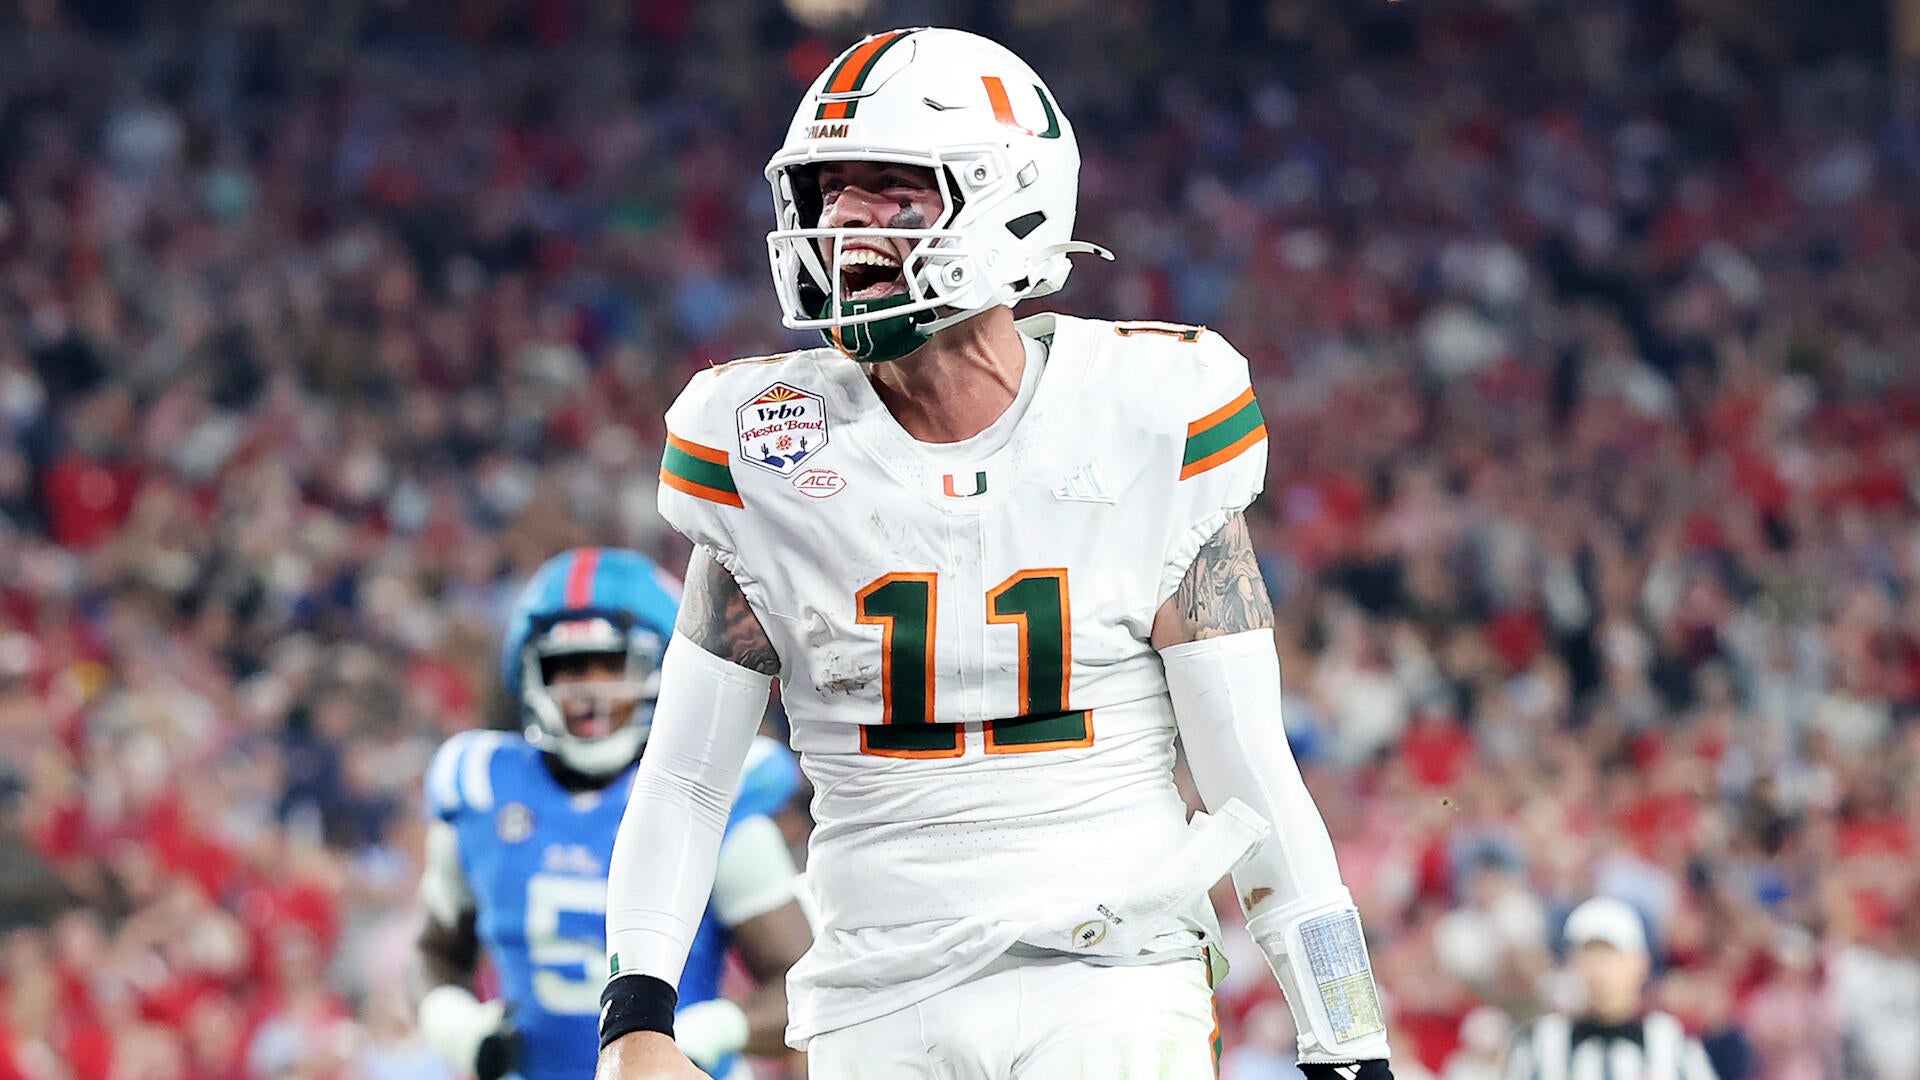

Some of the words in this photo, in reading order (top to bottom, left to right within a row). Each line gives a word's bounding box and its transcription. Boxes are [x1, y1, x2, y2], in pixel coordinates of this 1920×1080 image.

[980, 75, 1061, 139] U
[757, 403, 805, 422] Vrbo
[741, 423, 783, 442] Fiesta
[784, 420, 823, 430] Bowl
[800, 475, 839, 487] ACC
[942, 470, 988, 498] U
[855, 567, 1095, 760] 11
[525, 872, 608, 1016] 5
